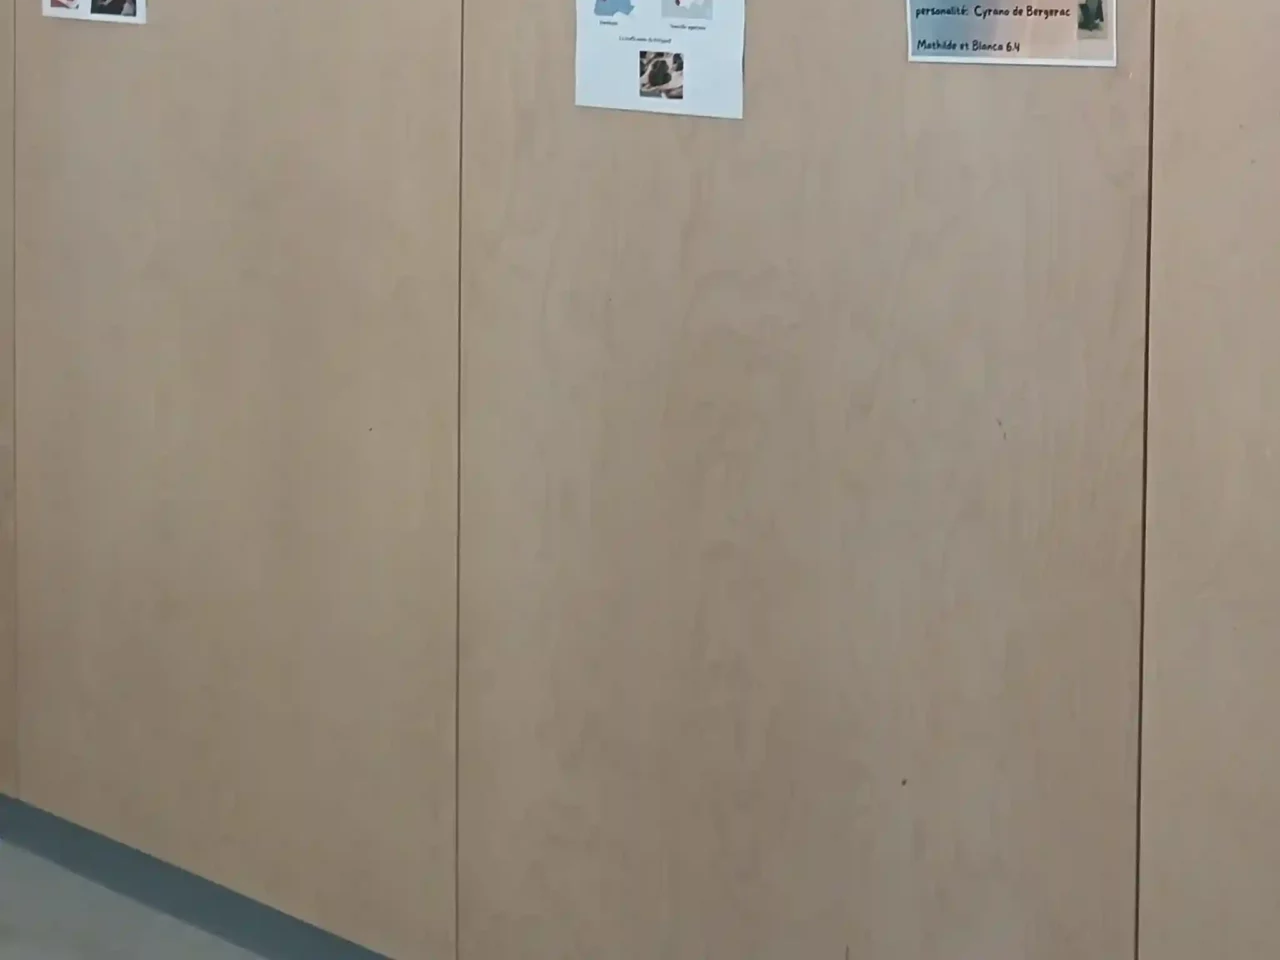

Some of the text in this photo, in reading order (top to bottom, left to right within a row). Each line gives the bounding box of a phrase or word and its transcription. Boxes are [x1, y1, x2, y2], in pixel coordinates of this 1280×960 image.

[973, 5, 1010, 19] Cyrano
[1012, 5, 1023, 16] de
[1026, 5, 1071, 20] Bergerac
[917, 39, 957, 51] Mathilde
[959, 40, 969, 51] et
